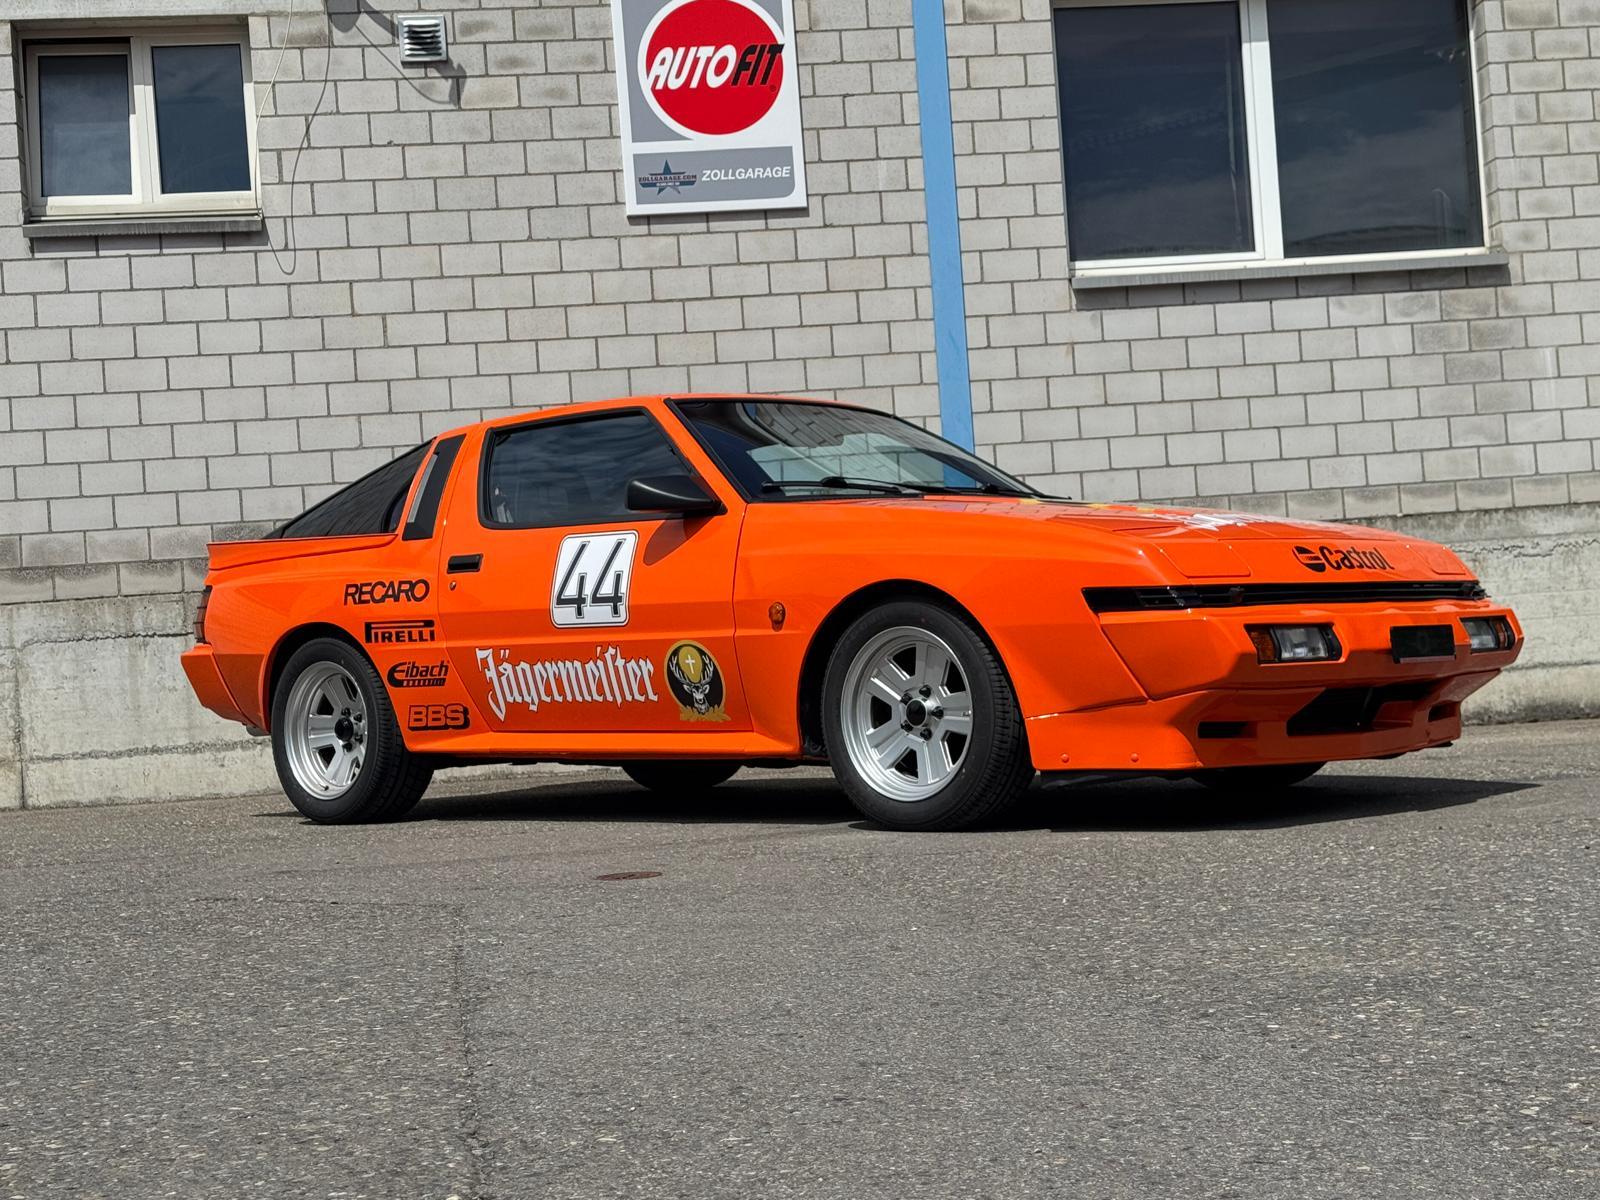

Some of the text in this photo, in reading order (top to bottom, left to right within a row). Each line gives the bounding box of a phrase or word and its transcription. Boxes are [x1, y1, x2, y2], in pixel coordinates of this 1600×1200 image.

[702, 166, 791, 182] ZOLLGARAGE
[1319, 545, 1395, 571] Castrol
[344, 578, 430, 606] RECARO
[554, 538, 626, 619] 44
[364, 619, 436, 644] PIRELLI
[387, 660, 449, 687] Eibach
[407, 703, 470, 731] BBS
